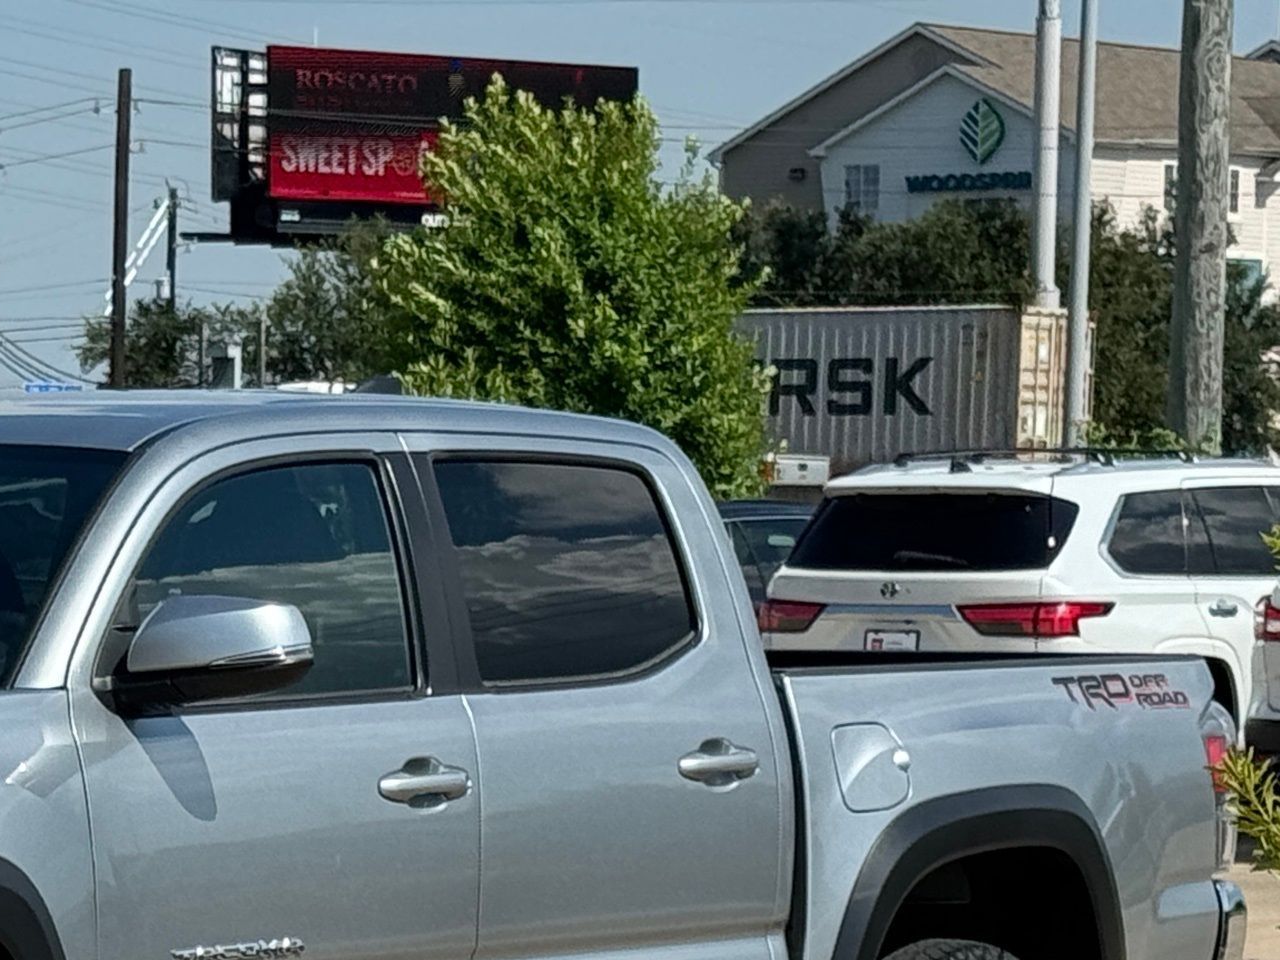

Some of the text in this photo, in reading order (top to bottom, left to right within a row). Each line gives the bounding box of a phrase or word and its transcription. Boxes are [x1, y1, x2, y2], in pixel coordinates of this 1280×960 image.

[295, 68, 418, 93] ROSCATO
[280, 137, 360, 175] SWEET
[753, 357, 933, 416] RSK
[1051, 673, 1133, 711] TRD
[1136, 691, 1190, 710] ROAD
